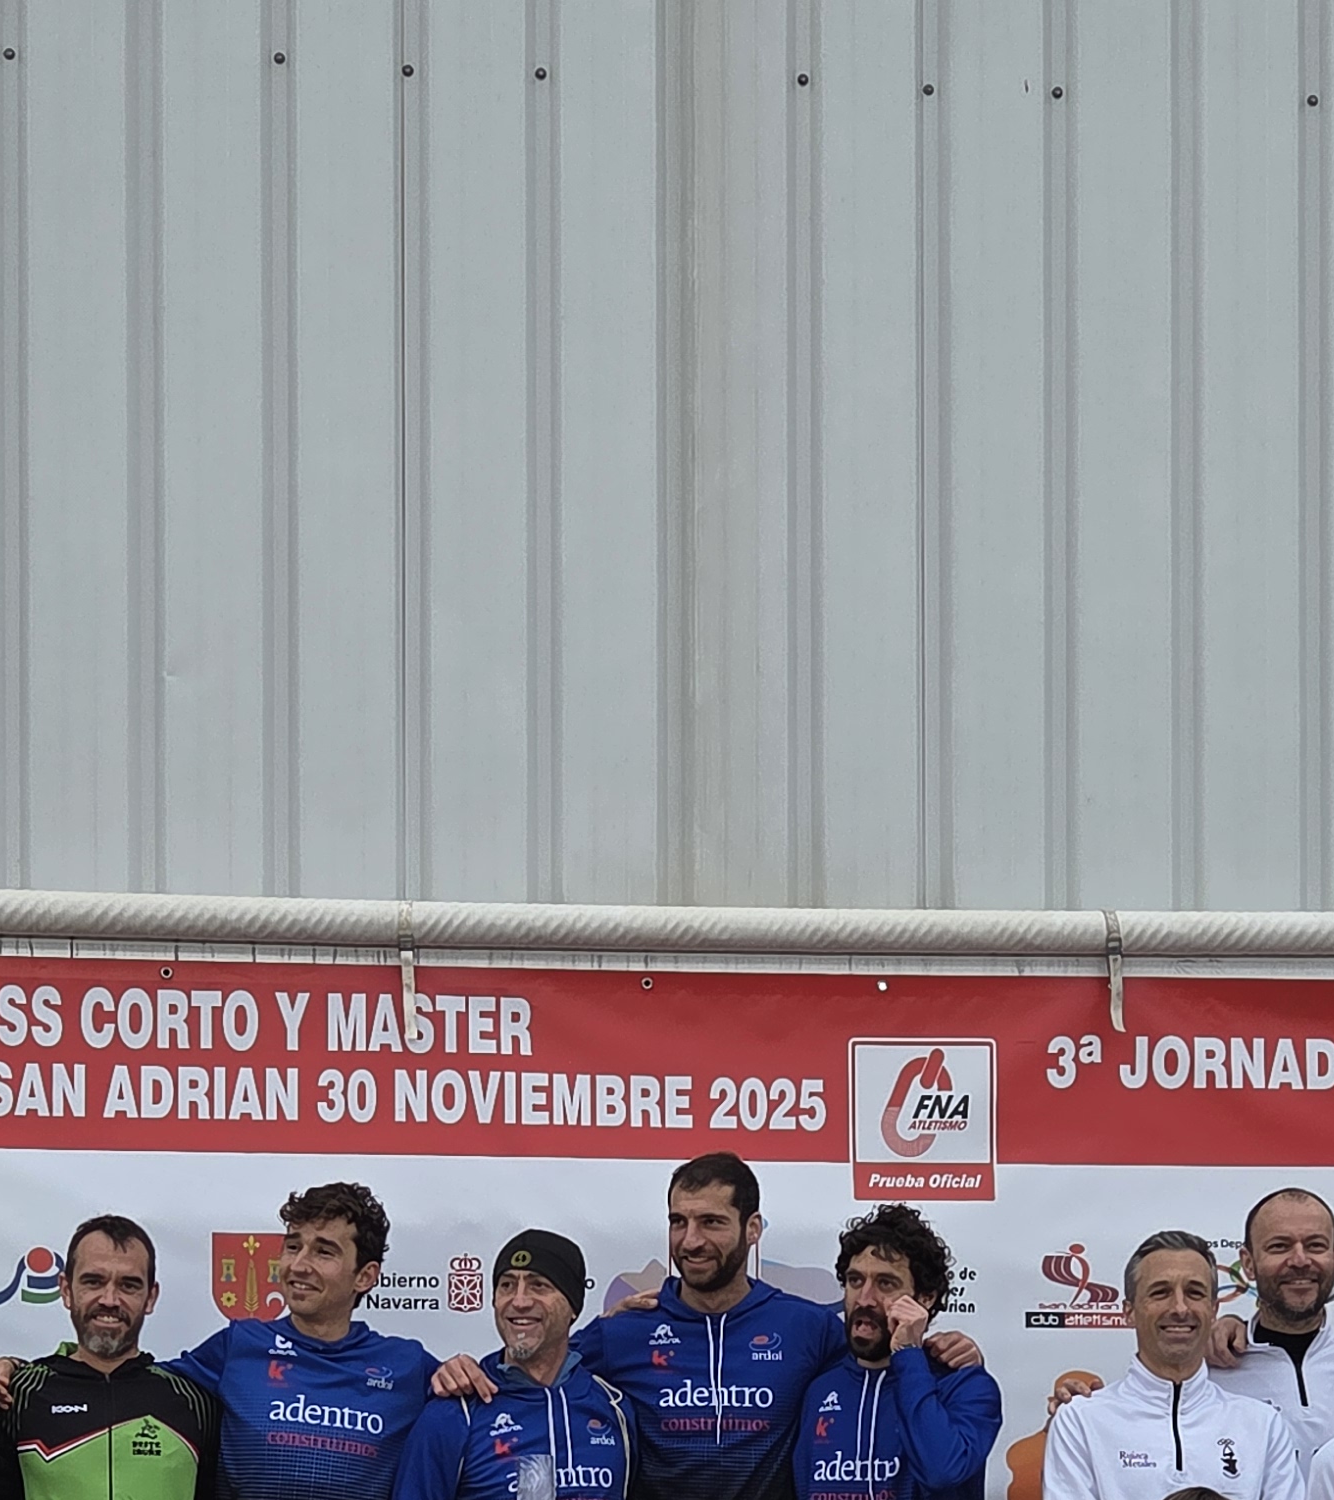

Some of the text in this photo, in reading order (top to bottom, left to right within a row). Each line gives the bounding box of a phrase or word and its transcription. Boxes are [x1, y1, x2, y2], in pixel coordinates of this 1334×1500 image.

[80, 987, 259, 1052] CORTO
[274, 990, 309, 1051] Y
[326, 991, 532, 1056] MASTER
[1046, 1035, 1102, 1089] 3ª
[103, 1064, 300, 1122] ADRIAN
[317, 1068, 377, 1123] 30
[394, 1070, 693, 1130] NOVIEMBRE
[709, 1077, 827, 1132] 2025
[912, 1094, 970, 1120] FNA
[907, 1120, 968, 1131] ATLETISMO
[868, 1173, 982, 1189] Prueba Oficial
[959, 1267, 977, 1280] de
[366, 1294, 440, 1310] Navarra
[1030, 1313, 1129, 1326] club atletism
[751, 1350, 783, 1361] ardoi
[658, 1379, 774, 1408] adentro
[269, 1394, 384, 1435] adentro
